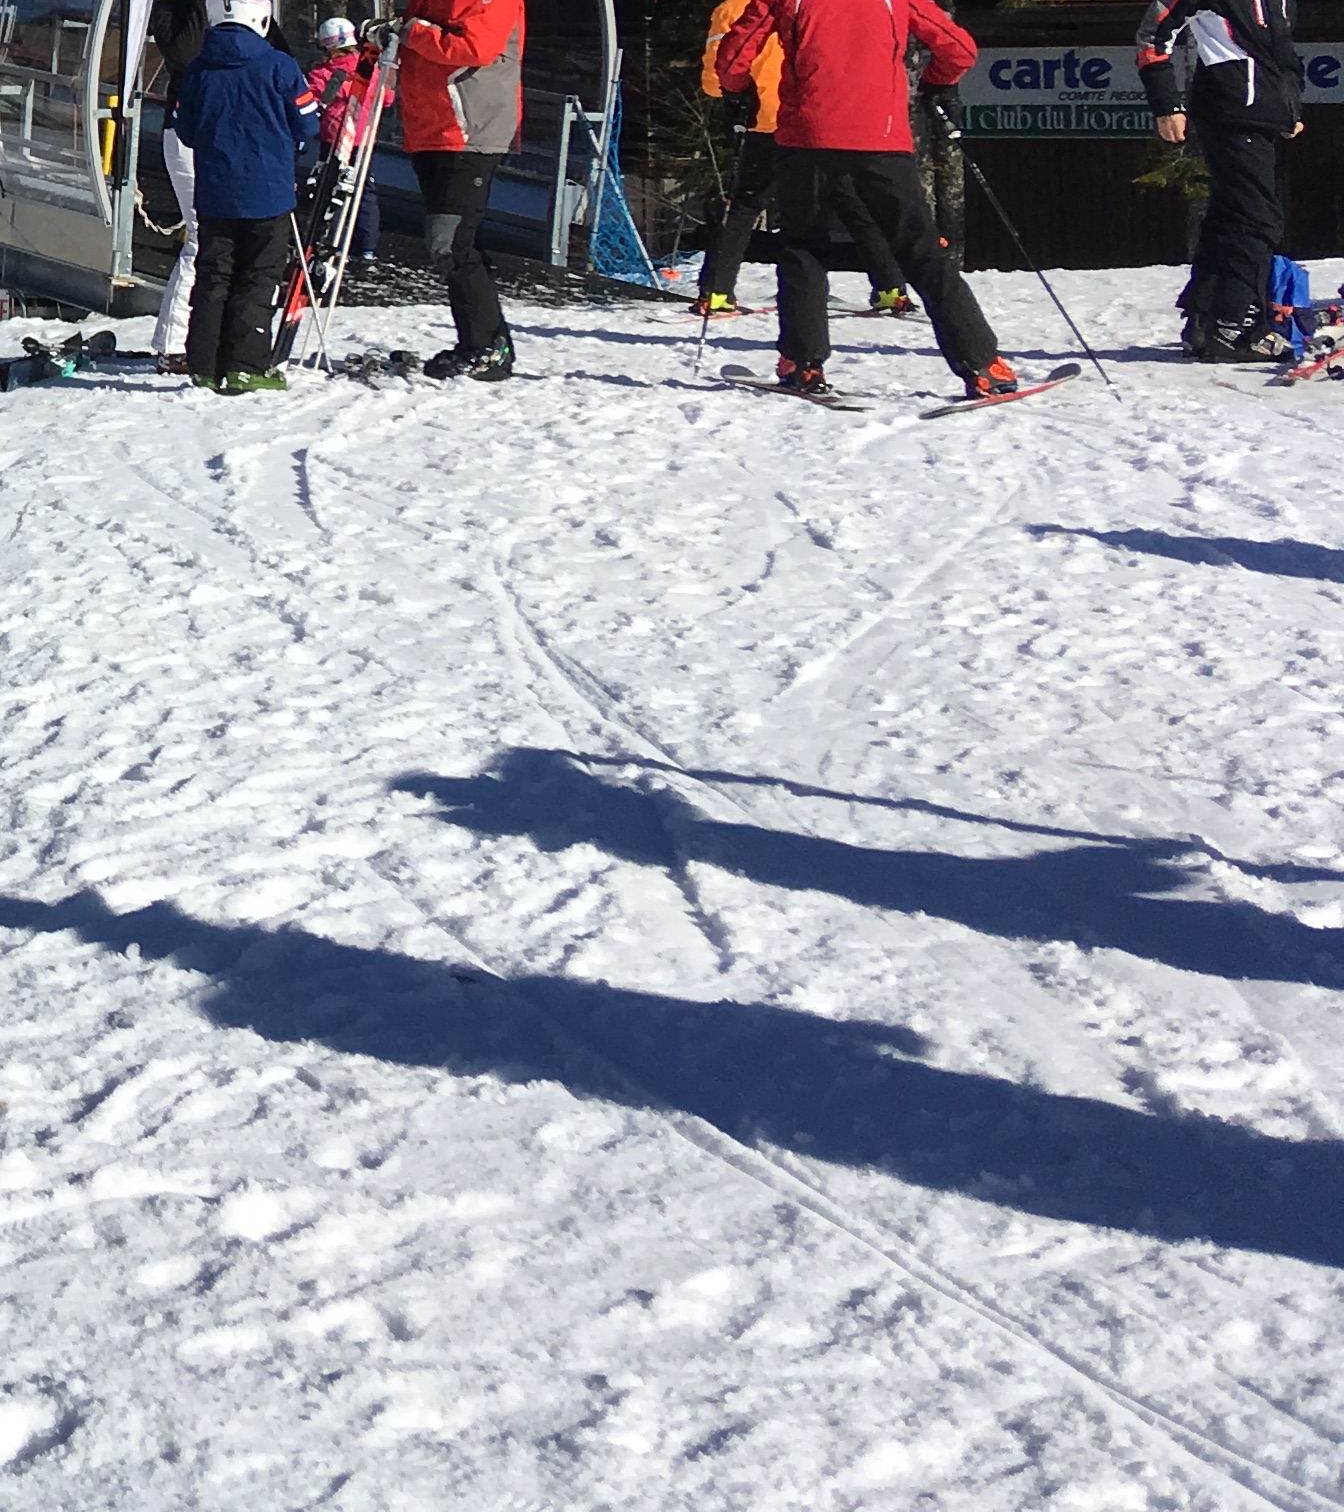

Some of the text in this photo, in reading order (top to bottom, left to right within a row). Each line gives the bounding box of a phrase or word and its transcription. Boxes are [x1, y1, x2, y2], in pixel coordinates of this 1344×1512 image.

[989, 49, 1112, 90] carte
[978, 105, 1033, 130] club
[1037, 105, 1065, 130] du
[1070, 102, 1156, 131] Lioran
